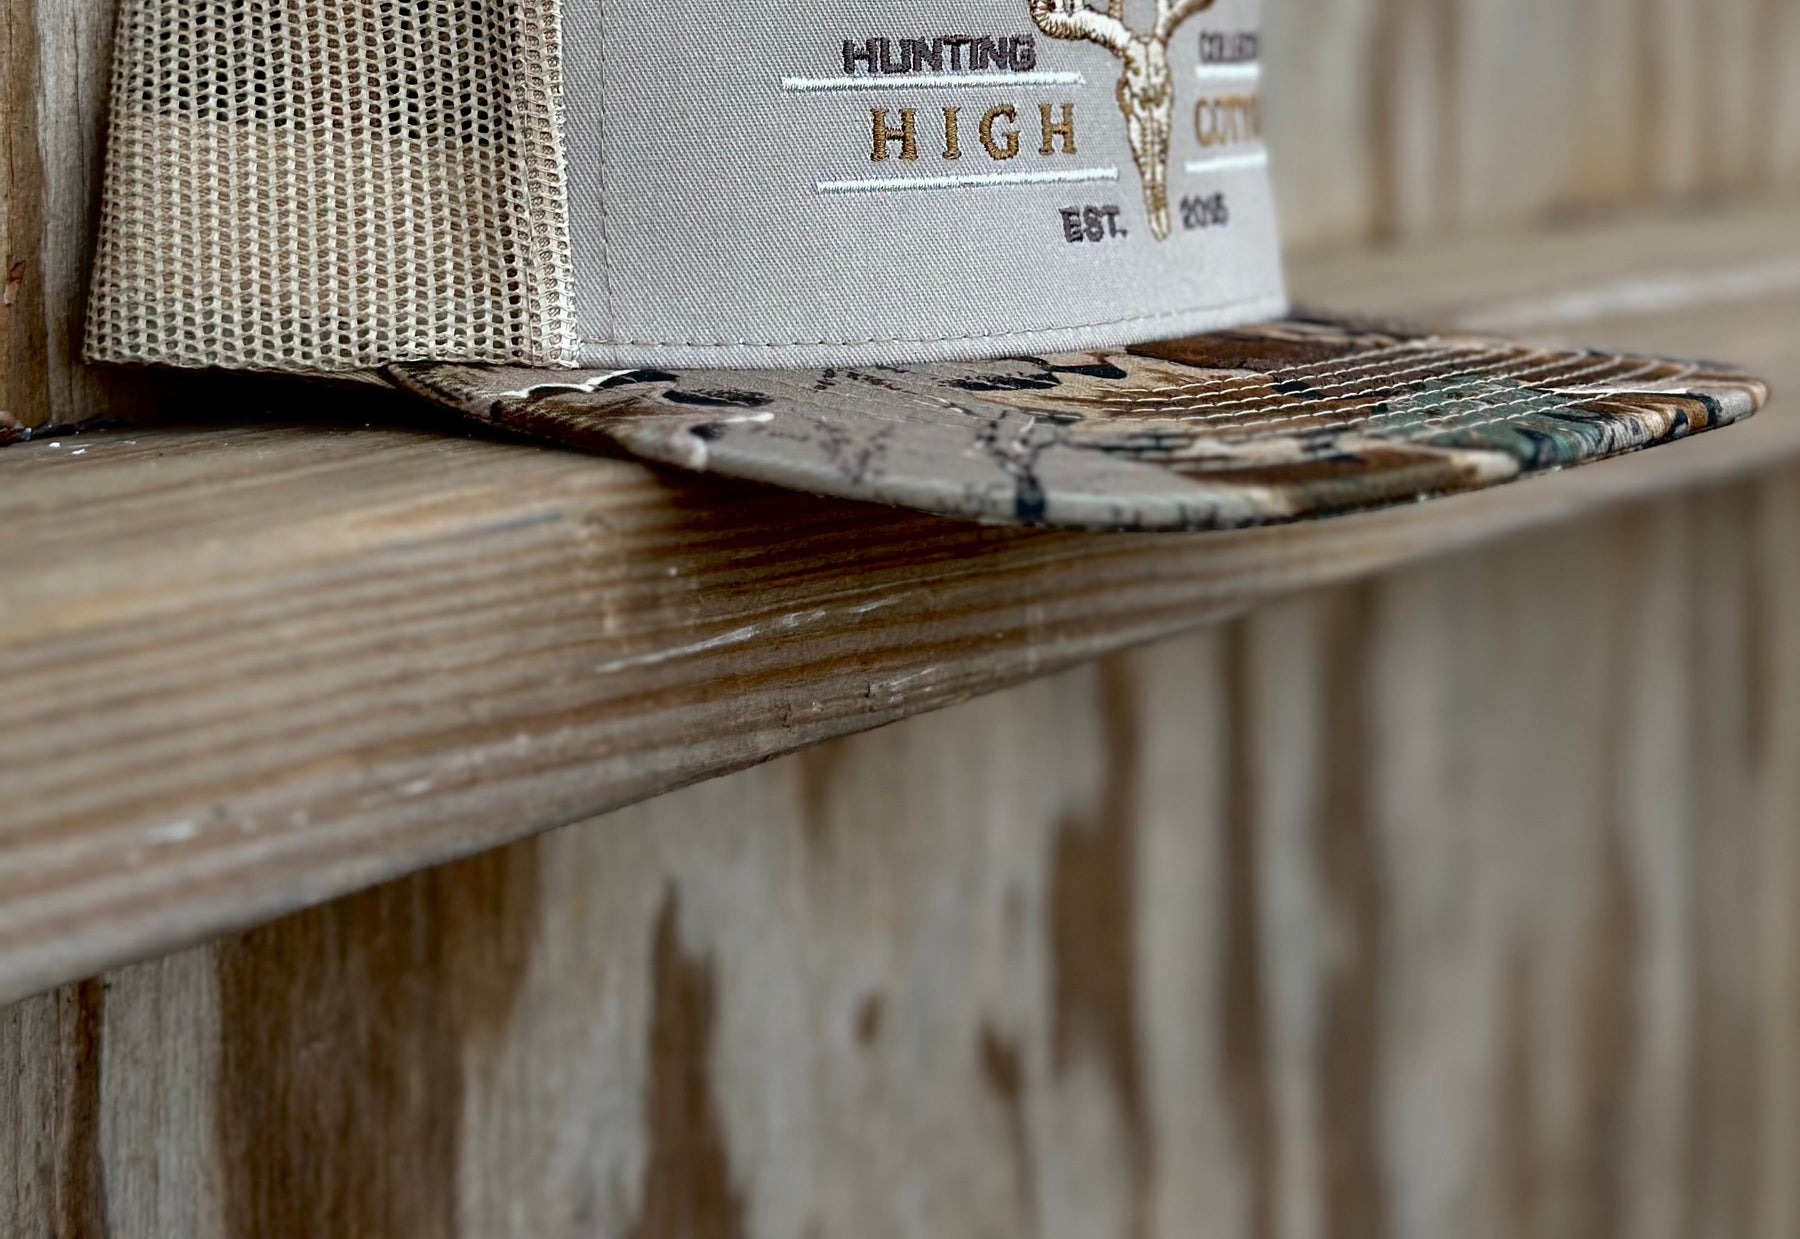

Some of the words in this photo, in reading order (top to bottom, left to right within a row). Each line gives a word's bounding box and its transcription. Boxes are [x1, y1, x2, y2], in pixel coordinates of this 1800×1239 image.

[841, 33, 1037, 74] HUNTING
[869, 102, 1078, 162] HIGH
[1058, 204, 1128, 243] EST.
